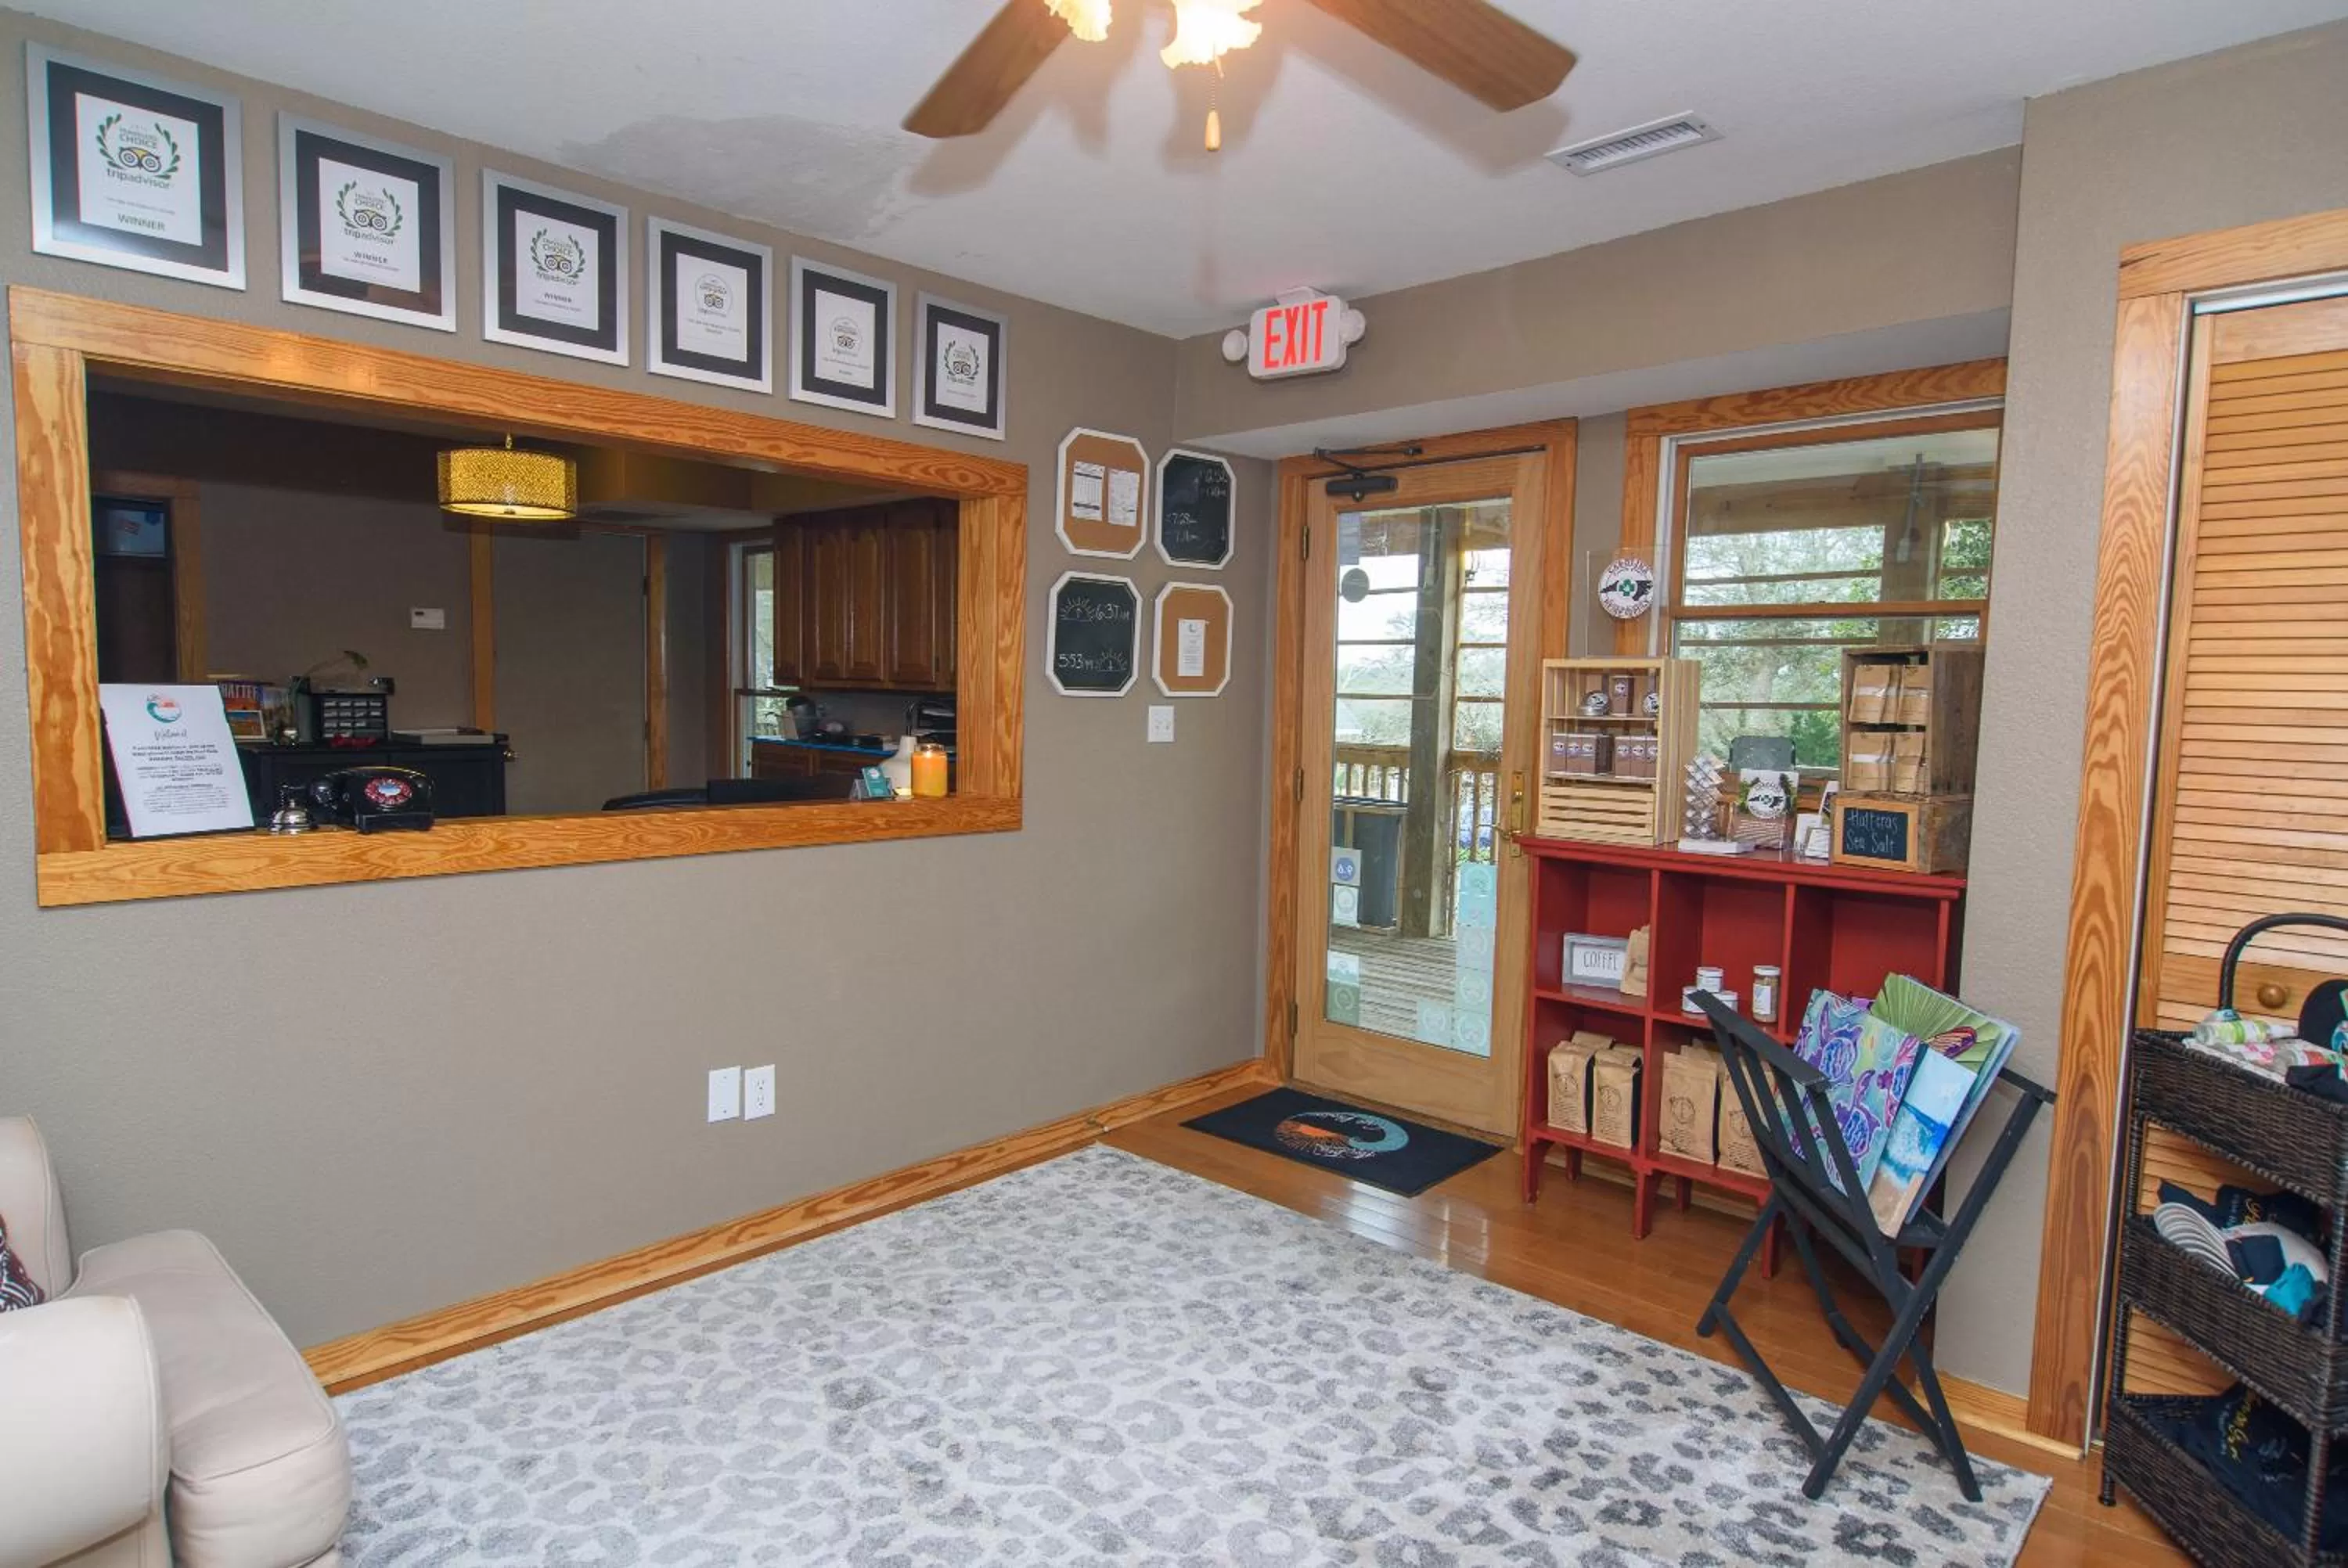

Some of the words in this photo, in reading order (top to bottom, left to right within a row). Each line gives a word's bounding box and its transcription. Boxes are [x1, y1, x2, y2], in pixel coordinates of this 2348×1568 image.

[117, 212, 166, 232] WINNER
[353, 250, 389, 264] WINNER
[1264, 300, 1328, 369] EXIT
[1846, 829, 1865, 852] Sea
[1871, 832, 1897, 856] Salt
